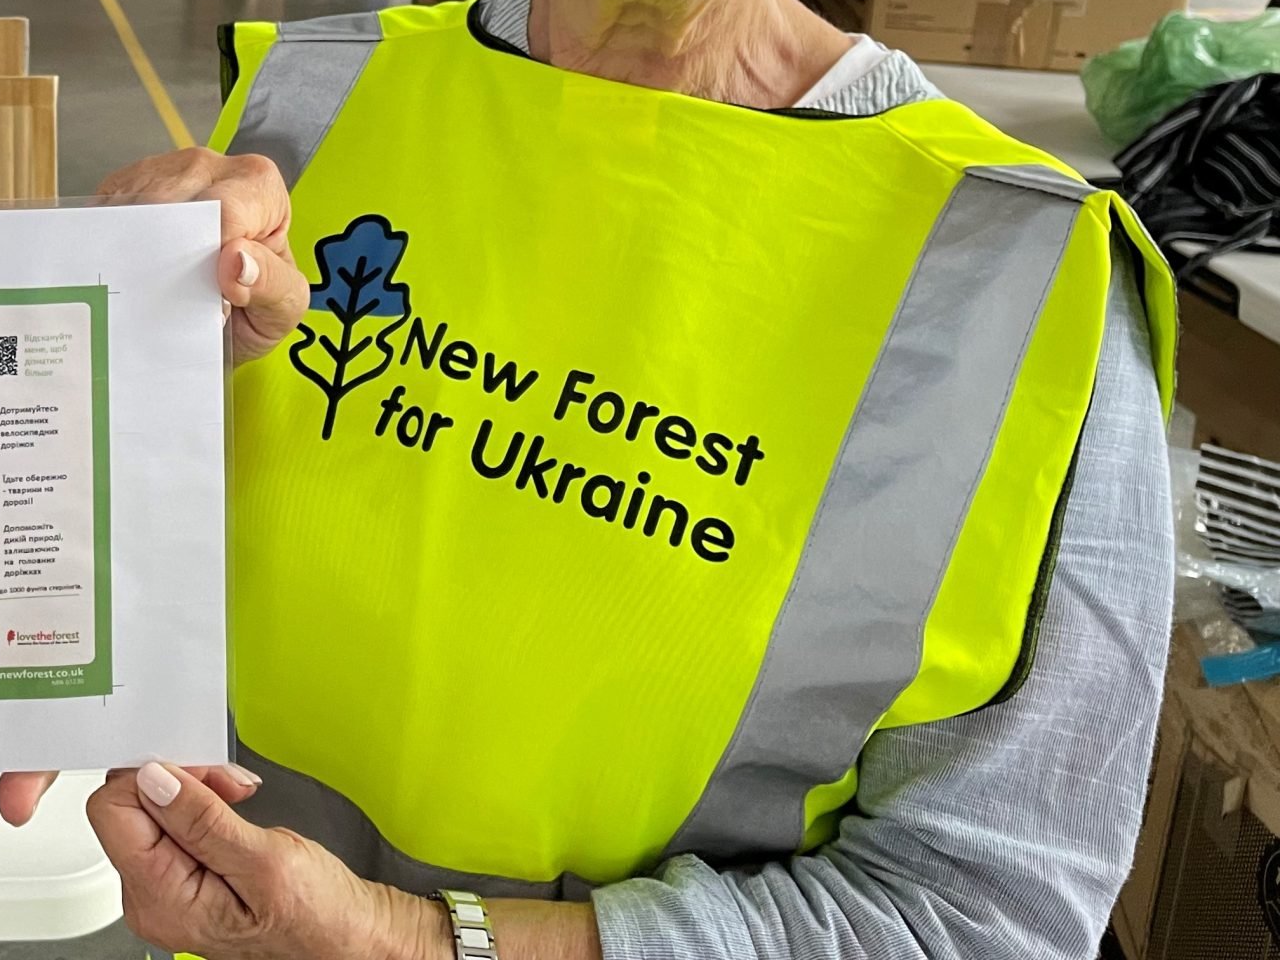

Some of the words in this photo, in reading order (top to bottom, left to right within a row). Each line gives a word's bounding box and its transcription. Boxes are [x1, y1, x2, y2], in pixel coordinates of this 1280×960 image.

[399, 316, 539, 402] New
[553, 369, 765, 486] Forest
[0, 405, 59, 415] Дотримуйтесь
[0, 429, 58, 437] велосипедних
[374, 385, 454, 452] for
[471, 419, 735, 563] Ukraine
[8, 487, 42, 495] тварини
[3, 524, 54, 533] Допоможіть
[4, 535, 26, 545] дикій
[17, 630, 79, 641] lovetheforest
